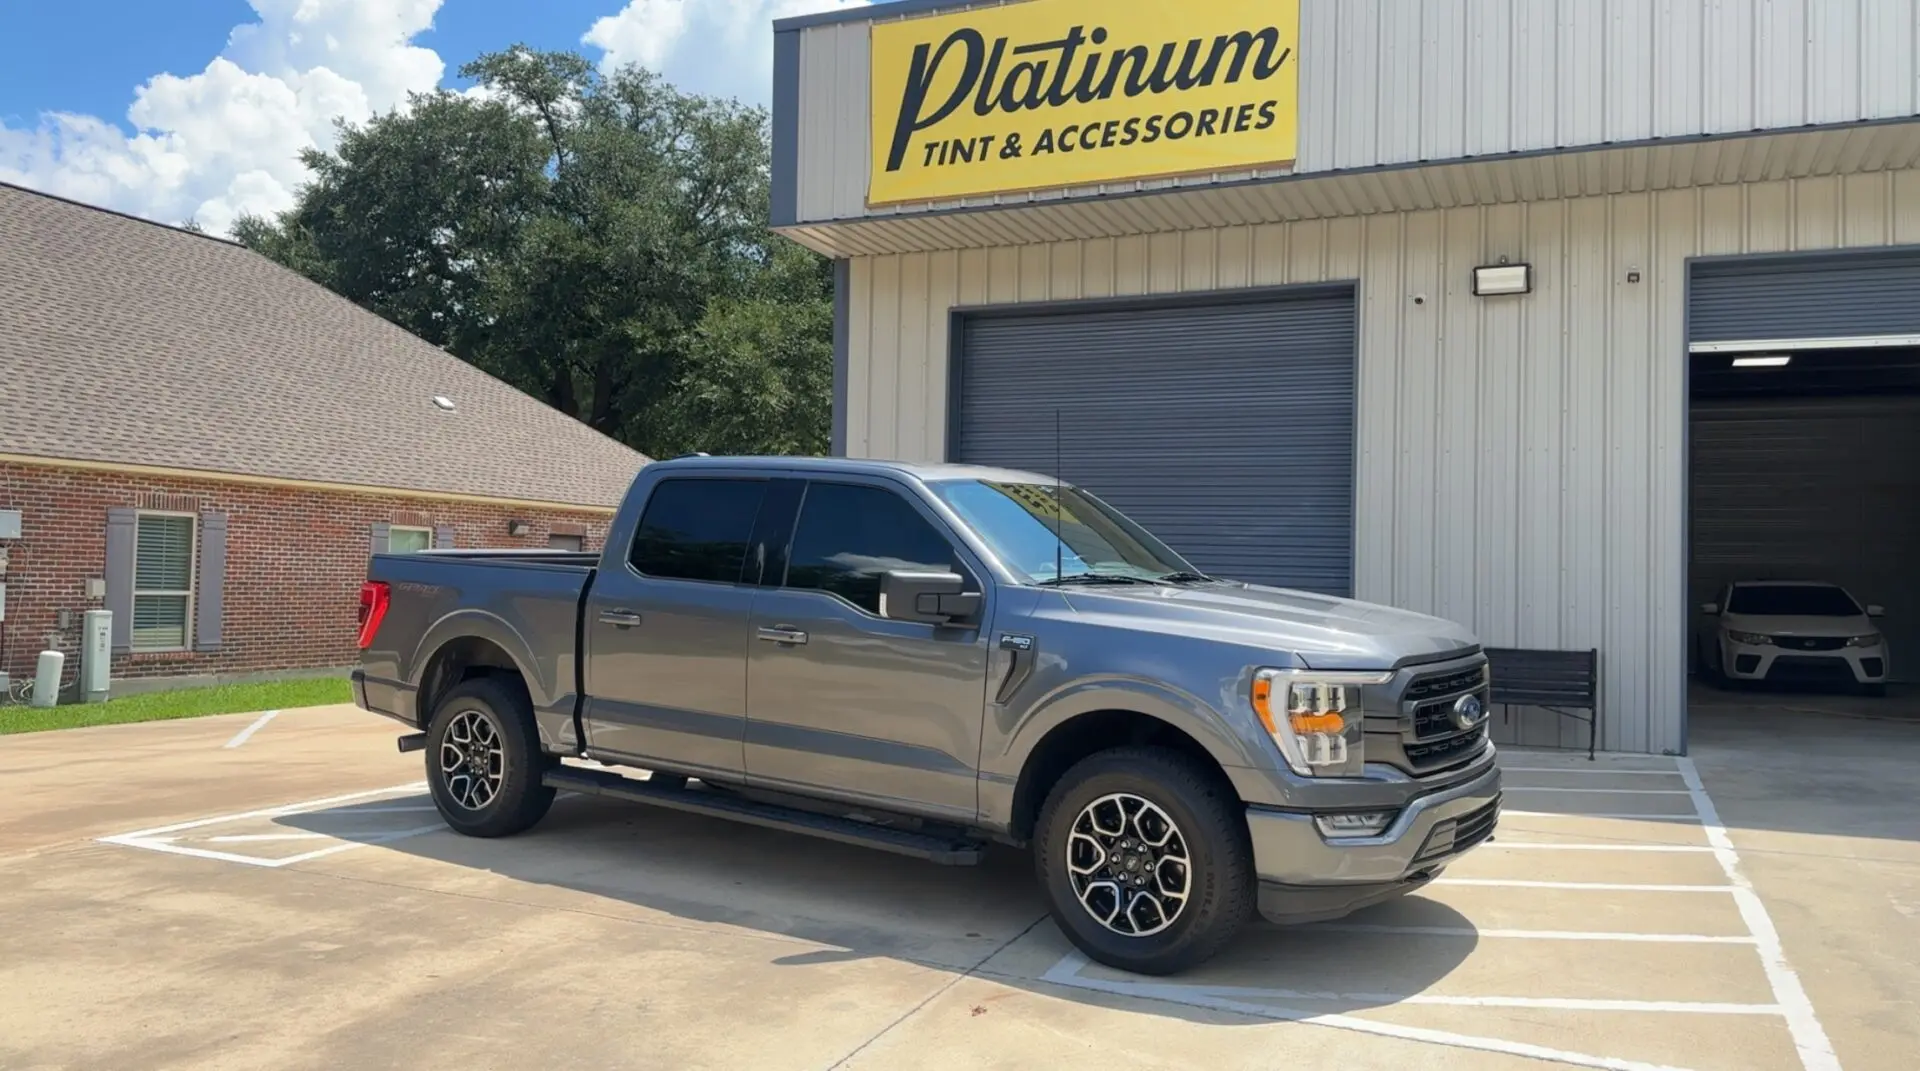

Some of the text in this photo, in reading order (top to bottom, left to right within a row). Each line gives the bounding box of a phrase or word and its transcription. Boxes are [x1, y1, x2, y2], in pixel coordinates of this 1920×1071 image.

[885, 25, 1290, 172] Platinum
[923, 100, 1278, 167] TINT & ACCESSORIES
